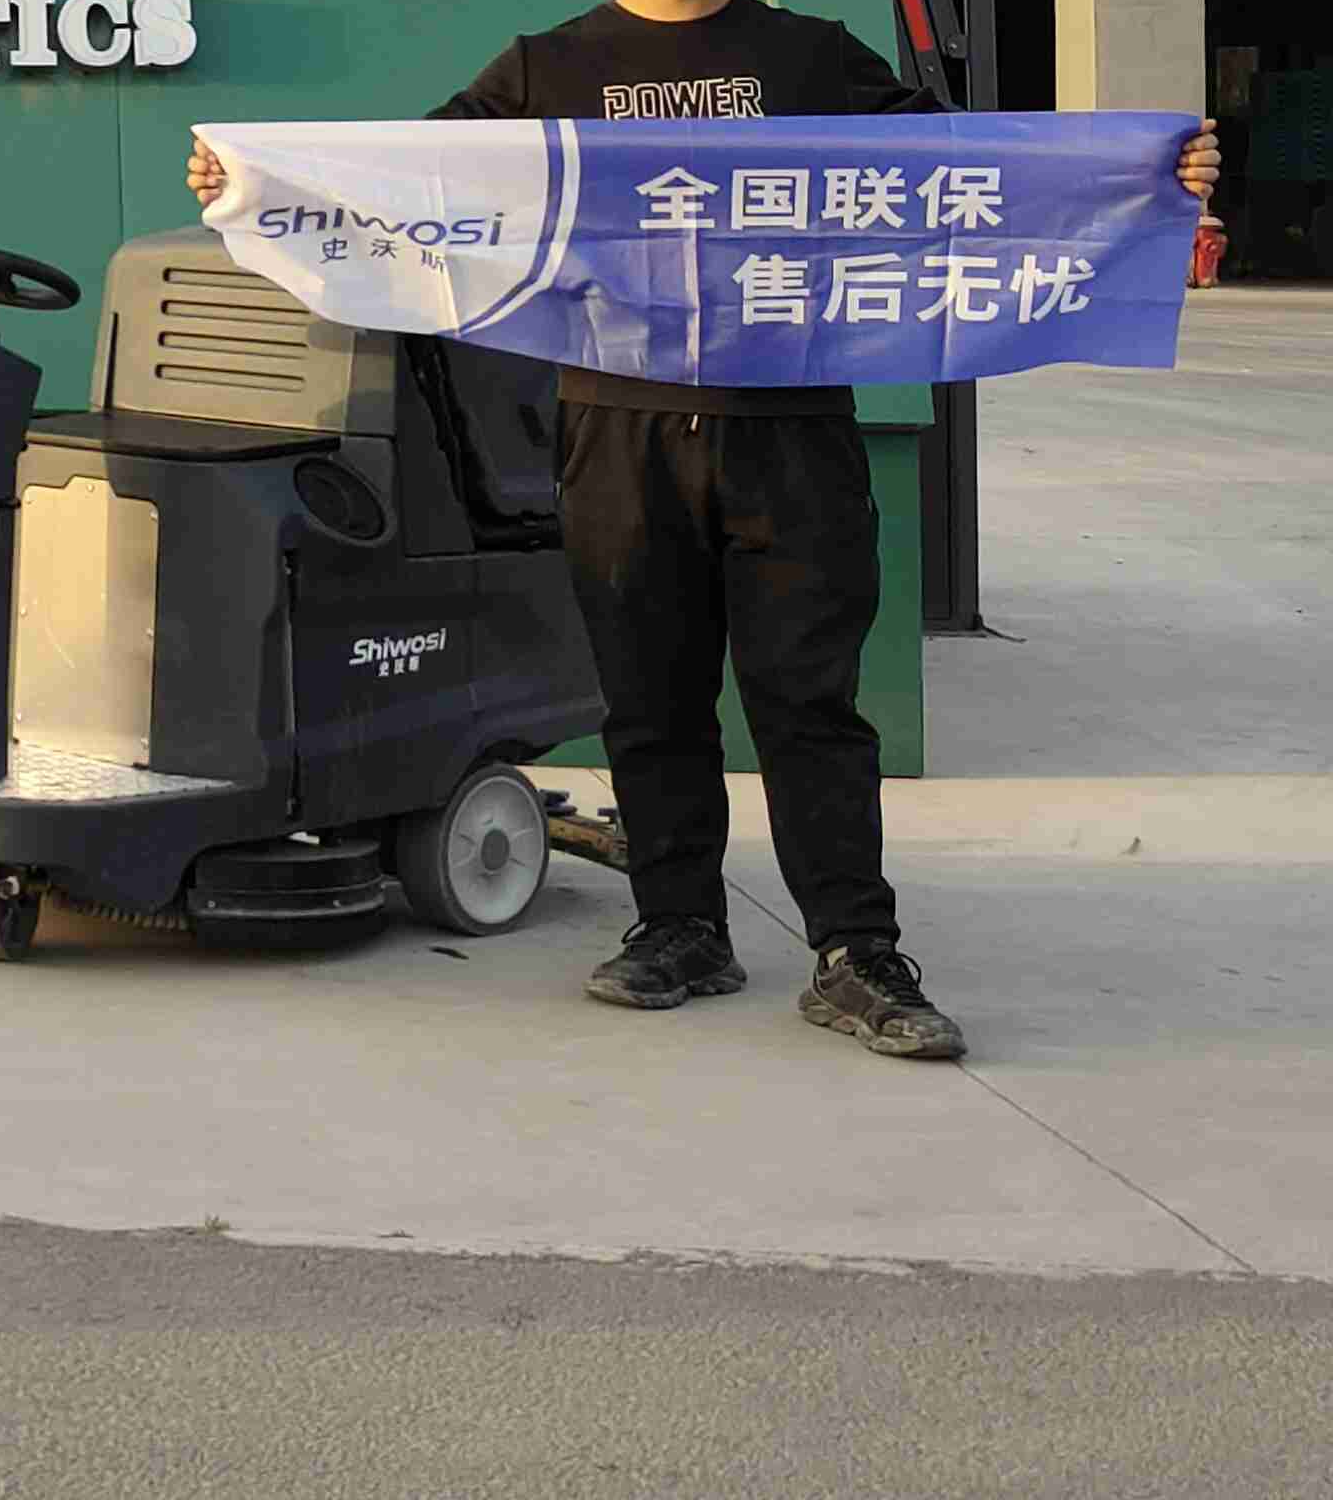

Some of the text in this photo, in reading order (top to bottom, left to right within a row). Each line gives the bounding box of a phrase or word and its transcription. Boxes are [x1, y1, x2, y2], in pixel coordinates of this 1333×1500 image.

[602, 76, 765, 120] POWER
[634, 165, 1005, 231] 全国联保
[732, 253, 1096, 326] 售后无忧
